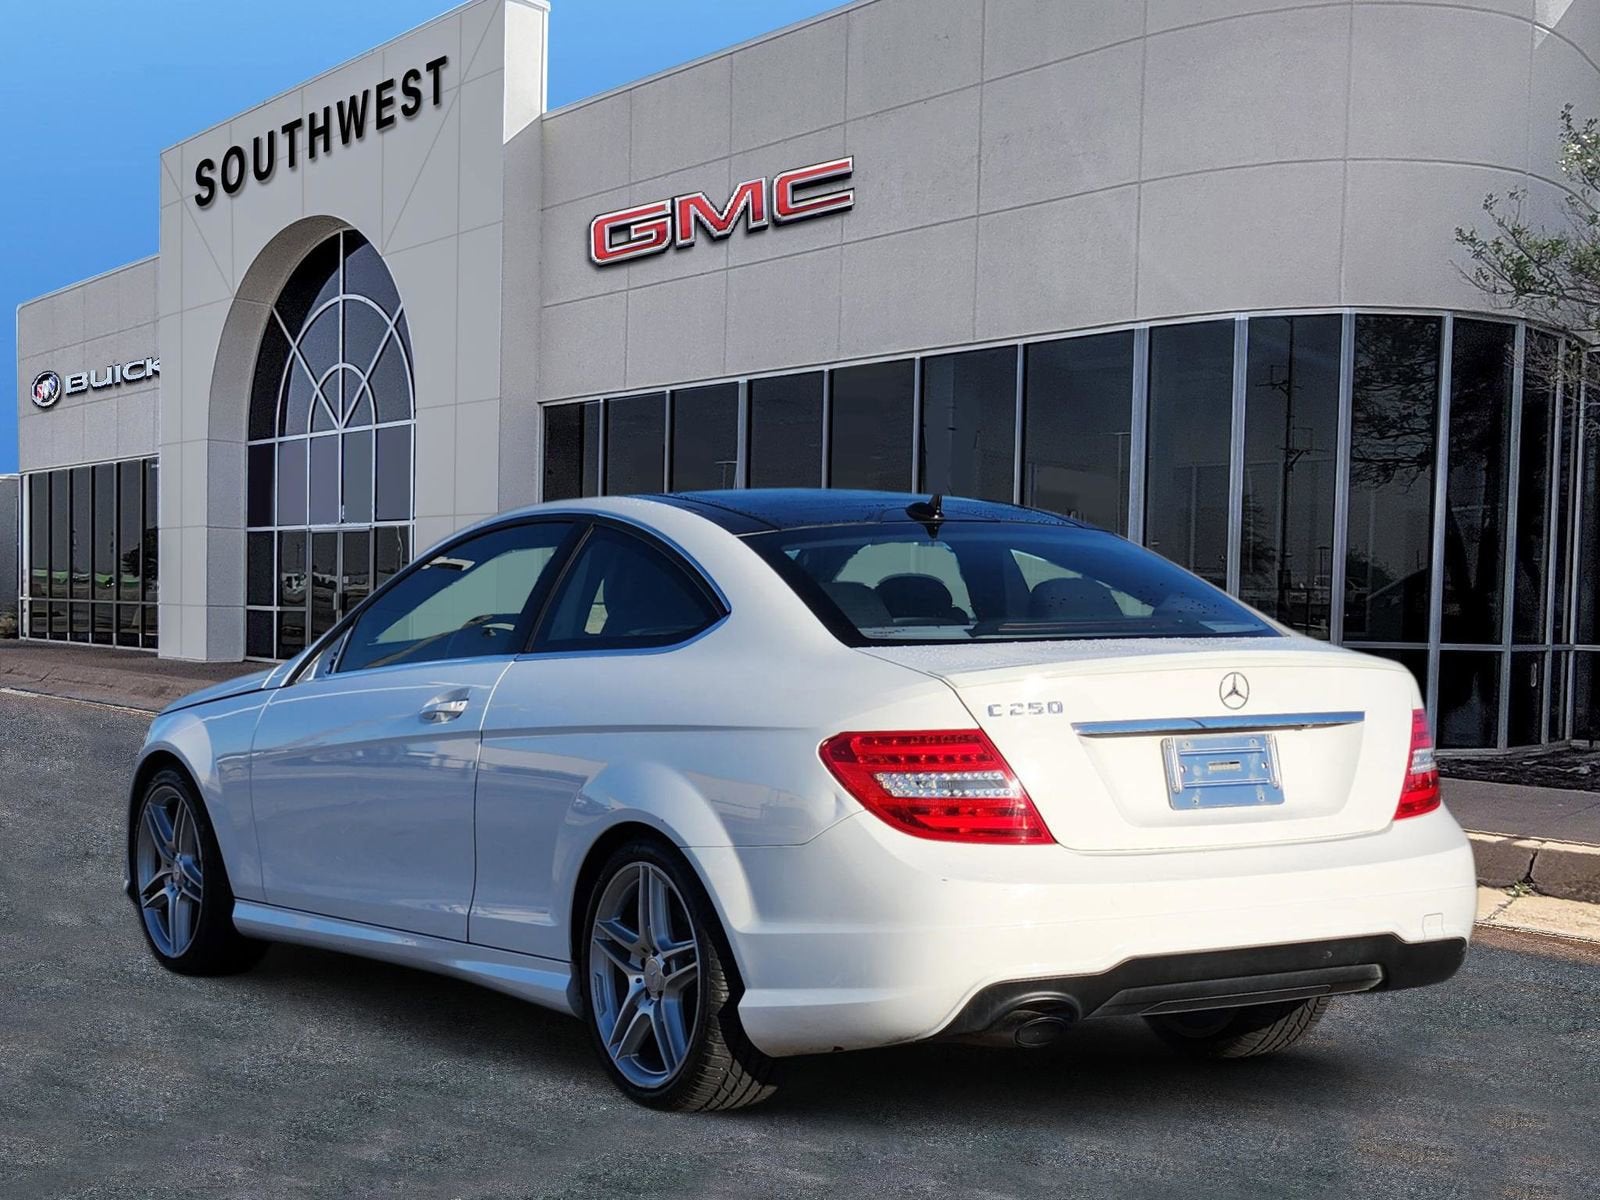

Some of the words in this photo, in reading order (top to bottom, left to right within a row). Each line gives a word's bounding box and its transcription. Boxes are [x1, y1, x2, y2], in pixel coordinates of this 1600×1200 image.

[194, 55, 448, 207] SOUTHWEST
[589, 155, 855, 266] GMC
[65, 357, 160, 395] BUICK
[987, 703, 1003, 718] C
[1009, 700, 1064, 717] 250
